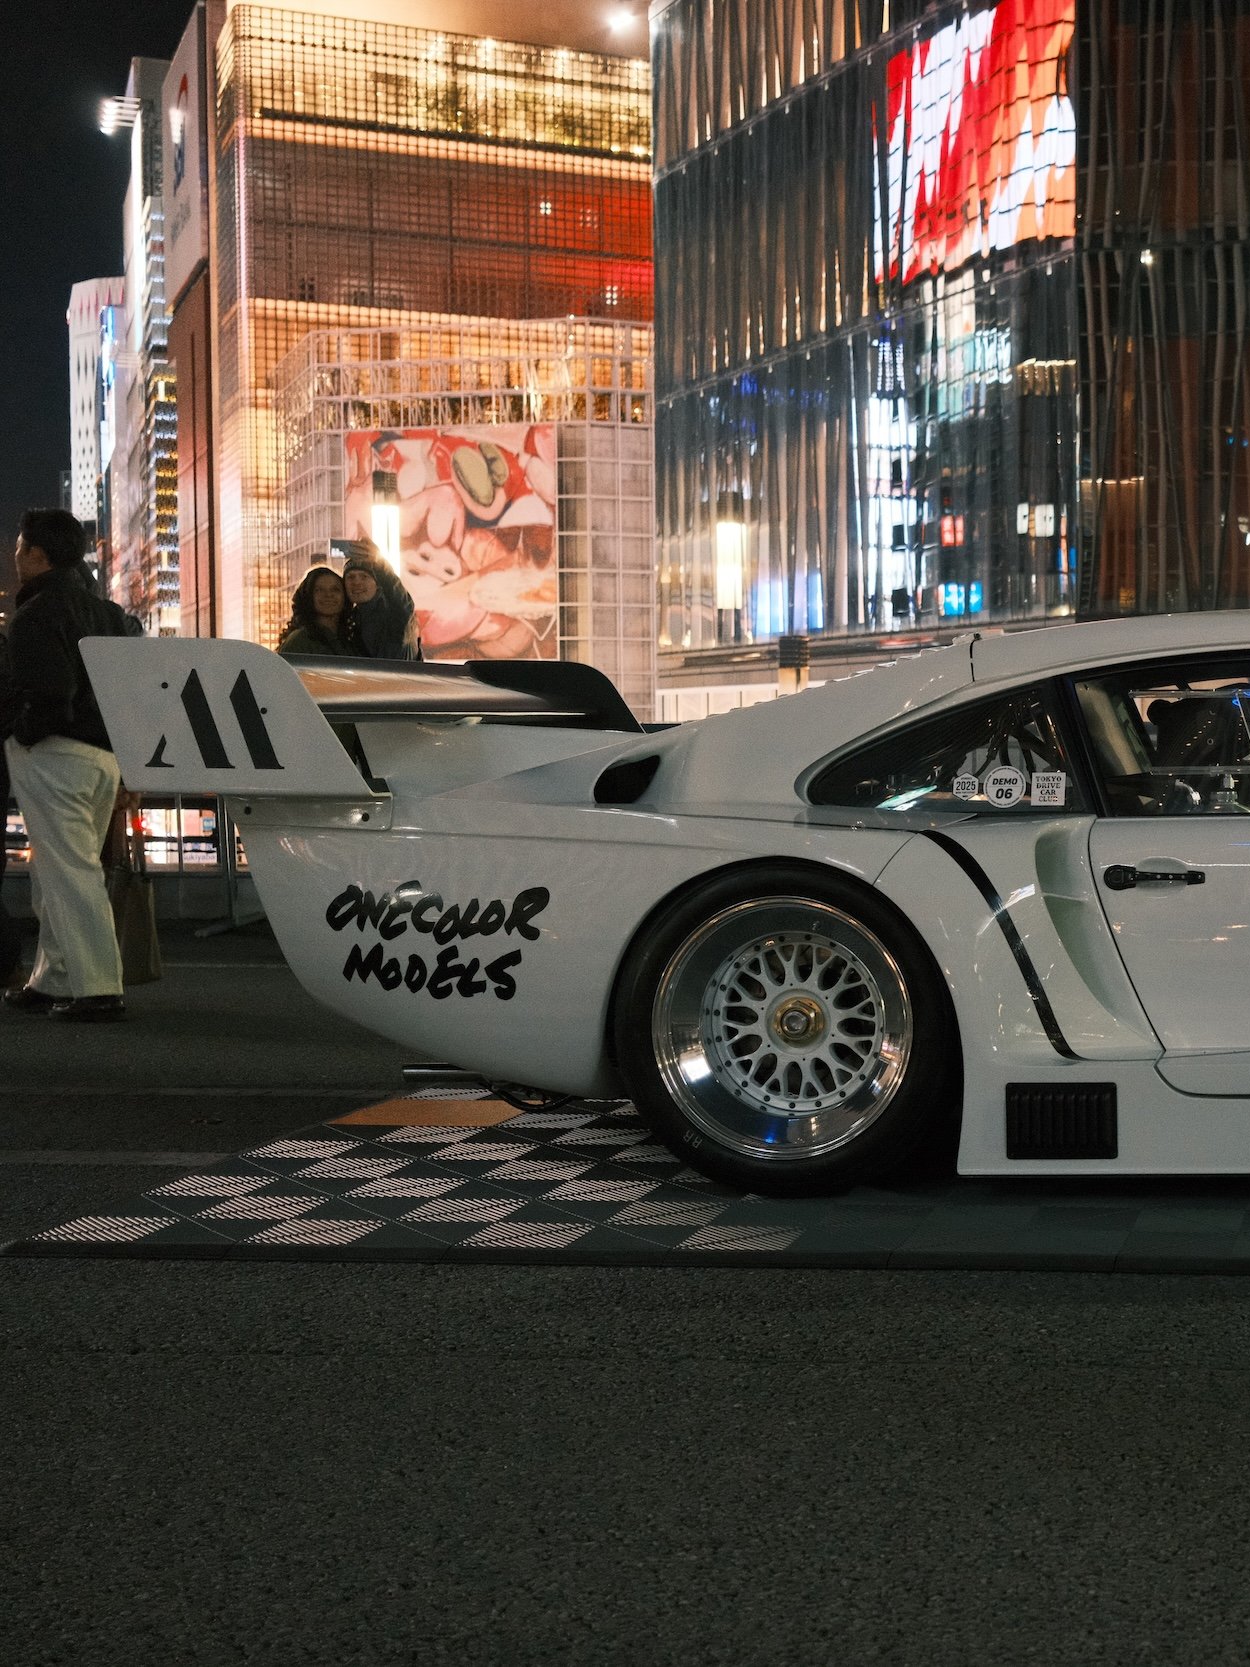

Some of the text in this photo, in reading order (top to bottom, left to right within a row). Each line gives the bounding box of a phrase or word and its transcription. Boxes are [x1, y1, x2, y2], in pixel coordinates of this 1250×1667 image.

[955, 781, 976, 791] 2025
[995, 788, 1013, 799] 06
[325, 879, 550, 946] ONECOLOR
[342, 942, 522, 1000] MODELS
